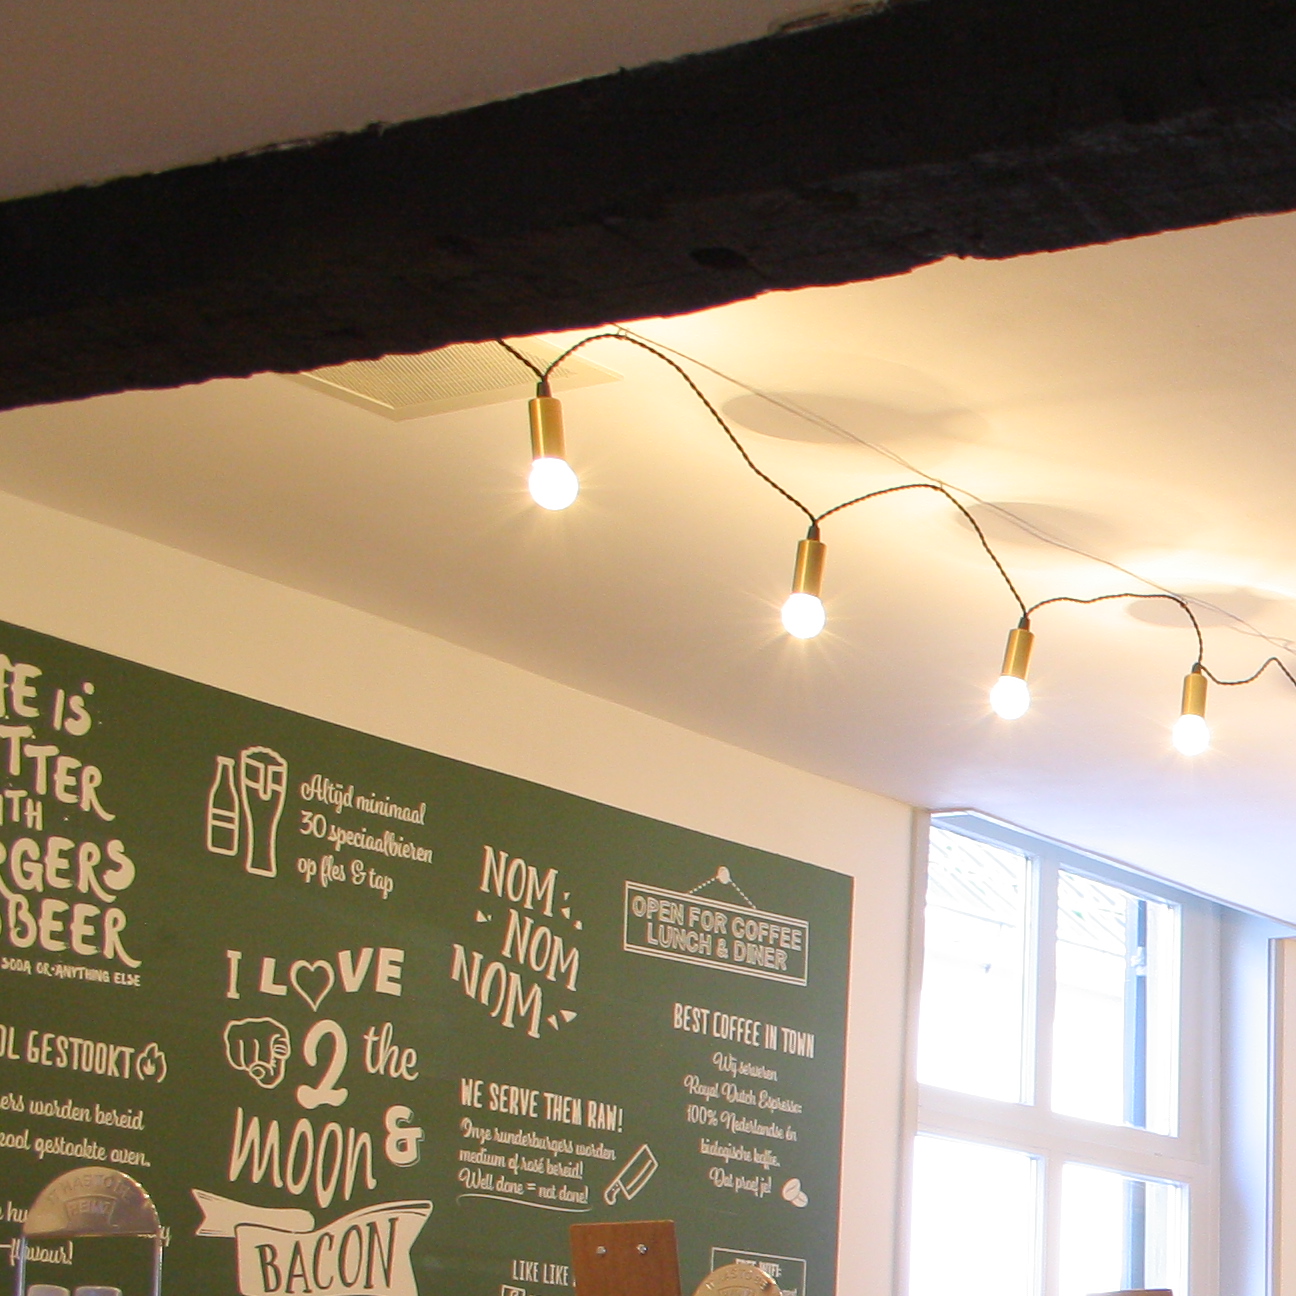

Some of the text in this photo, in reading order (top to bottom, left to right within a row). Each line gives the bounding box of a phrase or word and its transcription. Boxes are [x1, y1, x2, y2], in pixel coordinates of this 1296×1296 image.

[53, 686, 93, 736] IS
[0, 725, 116, 822] TTER
[356, 792, 427, 826] minimaal
[300, 810, 433, 863] 30 speciaalbieren
[297, 855, 394, 900] op fles & tap
[480, 845, 558, 917] NOM
[8, 896, 143, 966] BEER
[632, 895, 802, 951] OPEN FOR COFFEE
[647, 922, 788, 972] LUNCH & DINER
[2, 957, 32, 975] SODA
[54, 963, 110, 987] ANYTHING
[114, 968, 141, 987] ELSE
[227, 950, 242, 999] I
[502, 908, 580, 991] NOM
[451, 944, 543, 1039] NOM
[26, 1030, 135, 1080] GESTOOKT
[674, 1002, 815, 1059] BEST COFFEE IN TOWN
[296, 1019, 419, 1109] 2 the
[29, 1098, 91, 1122] worden
[95, 1103, 145, 1131] bereid
[460, 1078, 623, 1134] WE SERVE THEM RAW!
[684, 1075, 719, 1102] Royal
[721, 1082, 757, 1106] Dutch
[384, 1104, 424, 1167] &
[460, 1117, 617, 1162] Onze runderburgers worden
[687, 1104, 718, 1127] 100%
[720, 1111, 784, 1139] Nederlandse
[34, 1136, 106, 1160] gestookte
[110, 1147, 151, 1168] oven.
[459, 1147, 506, 1169] medium
[508, 1153, 519, 1176] of
[546, 1159, 584, 1181] bereid!
[700, 1138, 752, 1164] biologische
[458, 1167, 494, 1192] Well
[496, 1175, 524, 1197] done
[539, 1184, 558, 1202] not
[559, 1184, 589, 1205] done!
[709, 1167, 734, 1188] Dat
[253, 1217, 400, 1295] BACON
[512, 1259, 569, 1286] LIKE LIKE
